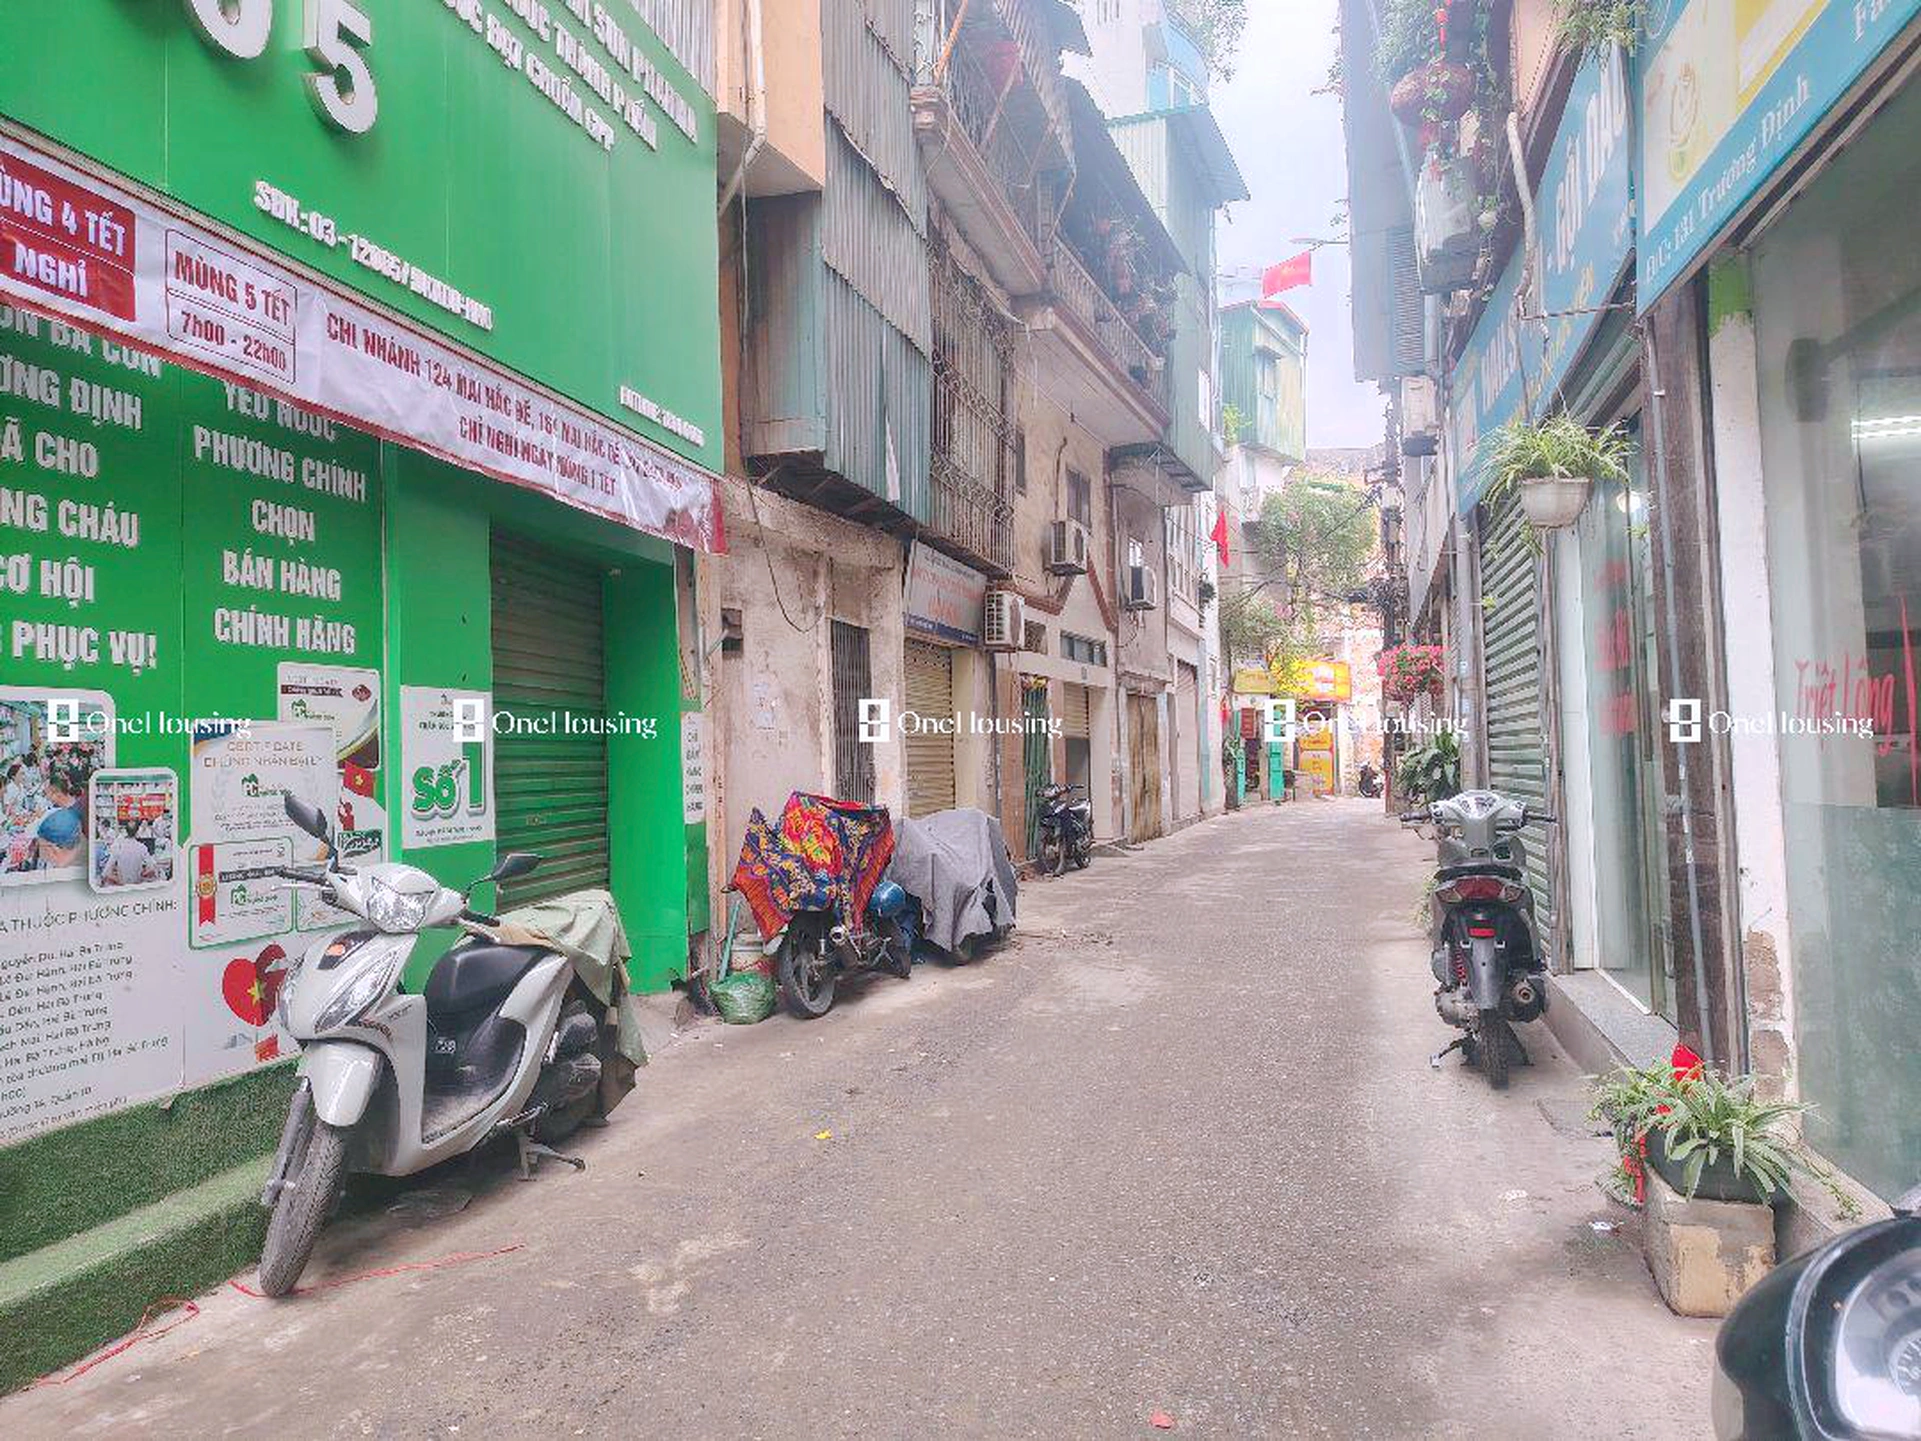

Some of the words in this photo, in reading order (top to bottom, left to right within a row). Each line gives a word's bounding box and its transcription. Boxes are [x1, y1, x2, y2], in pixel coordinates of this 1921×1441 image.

[61, 200, 78, 237] 4
[85, 209, 127, 257] TẾT
[14, 240, 89, 298] NGHỈ
[175, 250, 239, 304] MÙNG
[244, 282, 256, 312] 5
[261, 285, 292, 327] TẾT
[181, 309, 226, 347] 7h00
[243, 334, 287, 373] 22h00
[326, 312, 358, 349] CHI
[363, 329, 420, 378] NHÁNH
[425, 358, 452, 391] 124
[456, 373, 482, 404] MAI
[69, 376, 143, 431] ĐỊNH
[35, 430, 100, 479] CHO
[193, 424, 295, 484] PHƯƠNG
[302, 456, 367, 501] CHÍNH
[57, 499, 140, 549] CHÁU
[251, 498, 316, 548] CHỌN
[40, 556, 95, 610] HỘI
[222, 547, 274, 591] BÁN
[280, 556, 342, 602] HÀNG
[12, 619, 100, 671] PHỤC
[109, 630, 157, 677] VỤ!
[213, 604, 290, 650] CHÍNH
[296, 614, 356, 655] HÃNG
